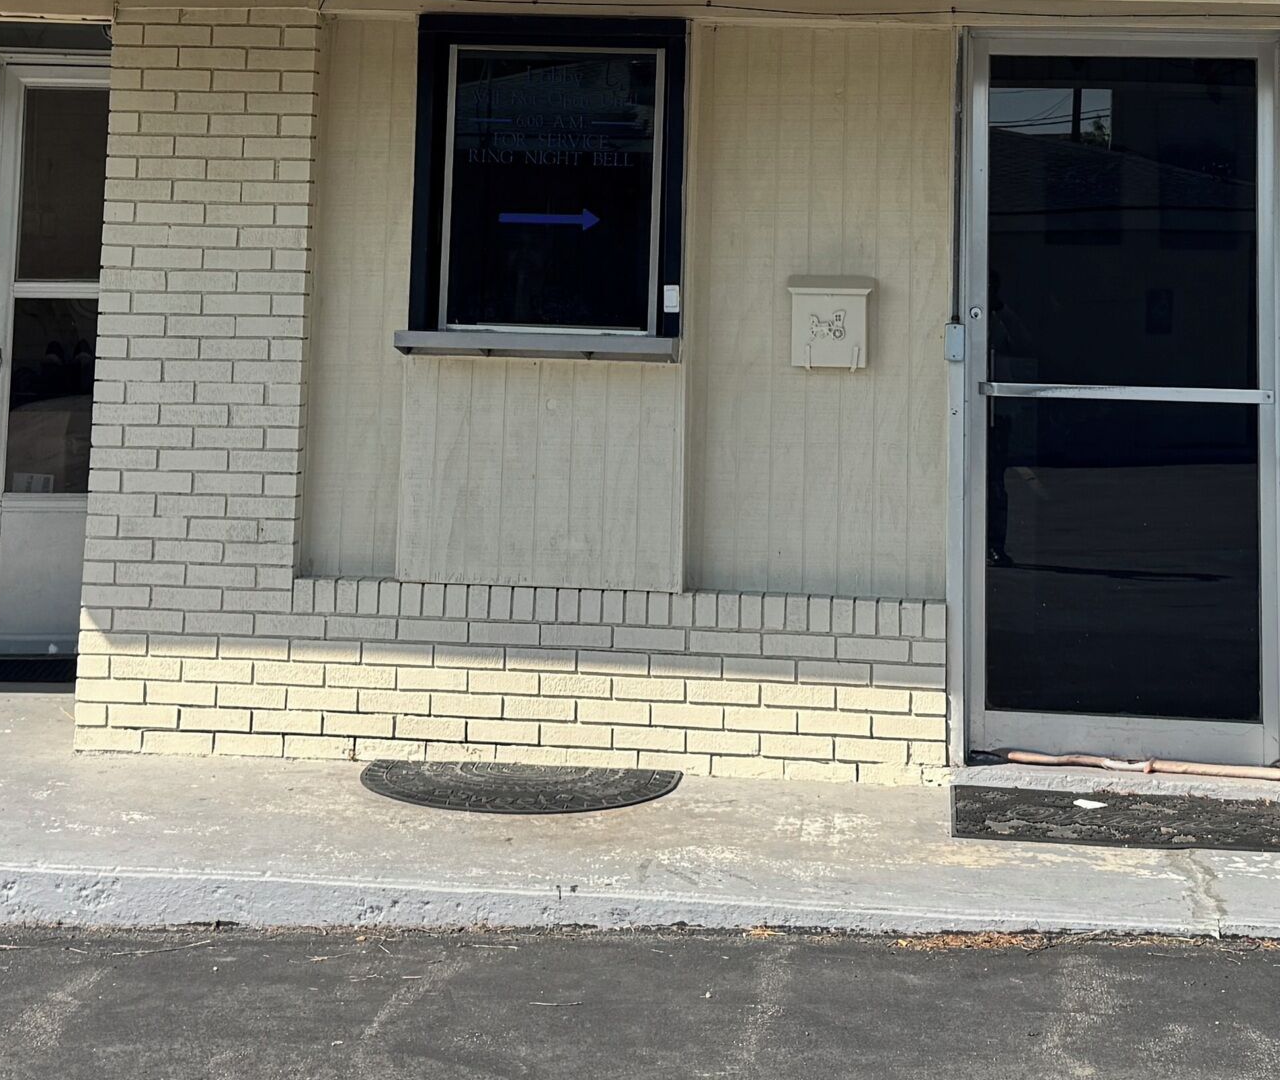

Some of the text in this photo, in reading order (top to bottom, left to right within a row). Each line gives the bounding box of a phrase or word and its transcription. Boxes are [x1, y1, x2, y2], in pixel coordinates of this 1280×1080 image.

[492, 131, 610, 150] FOR SERVICE
[468, 147, 635, 167] RING NIGHT BELL
